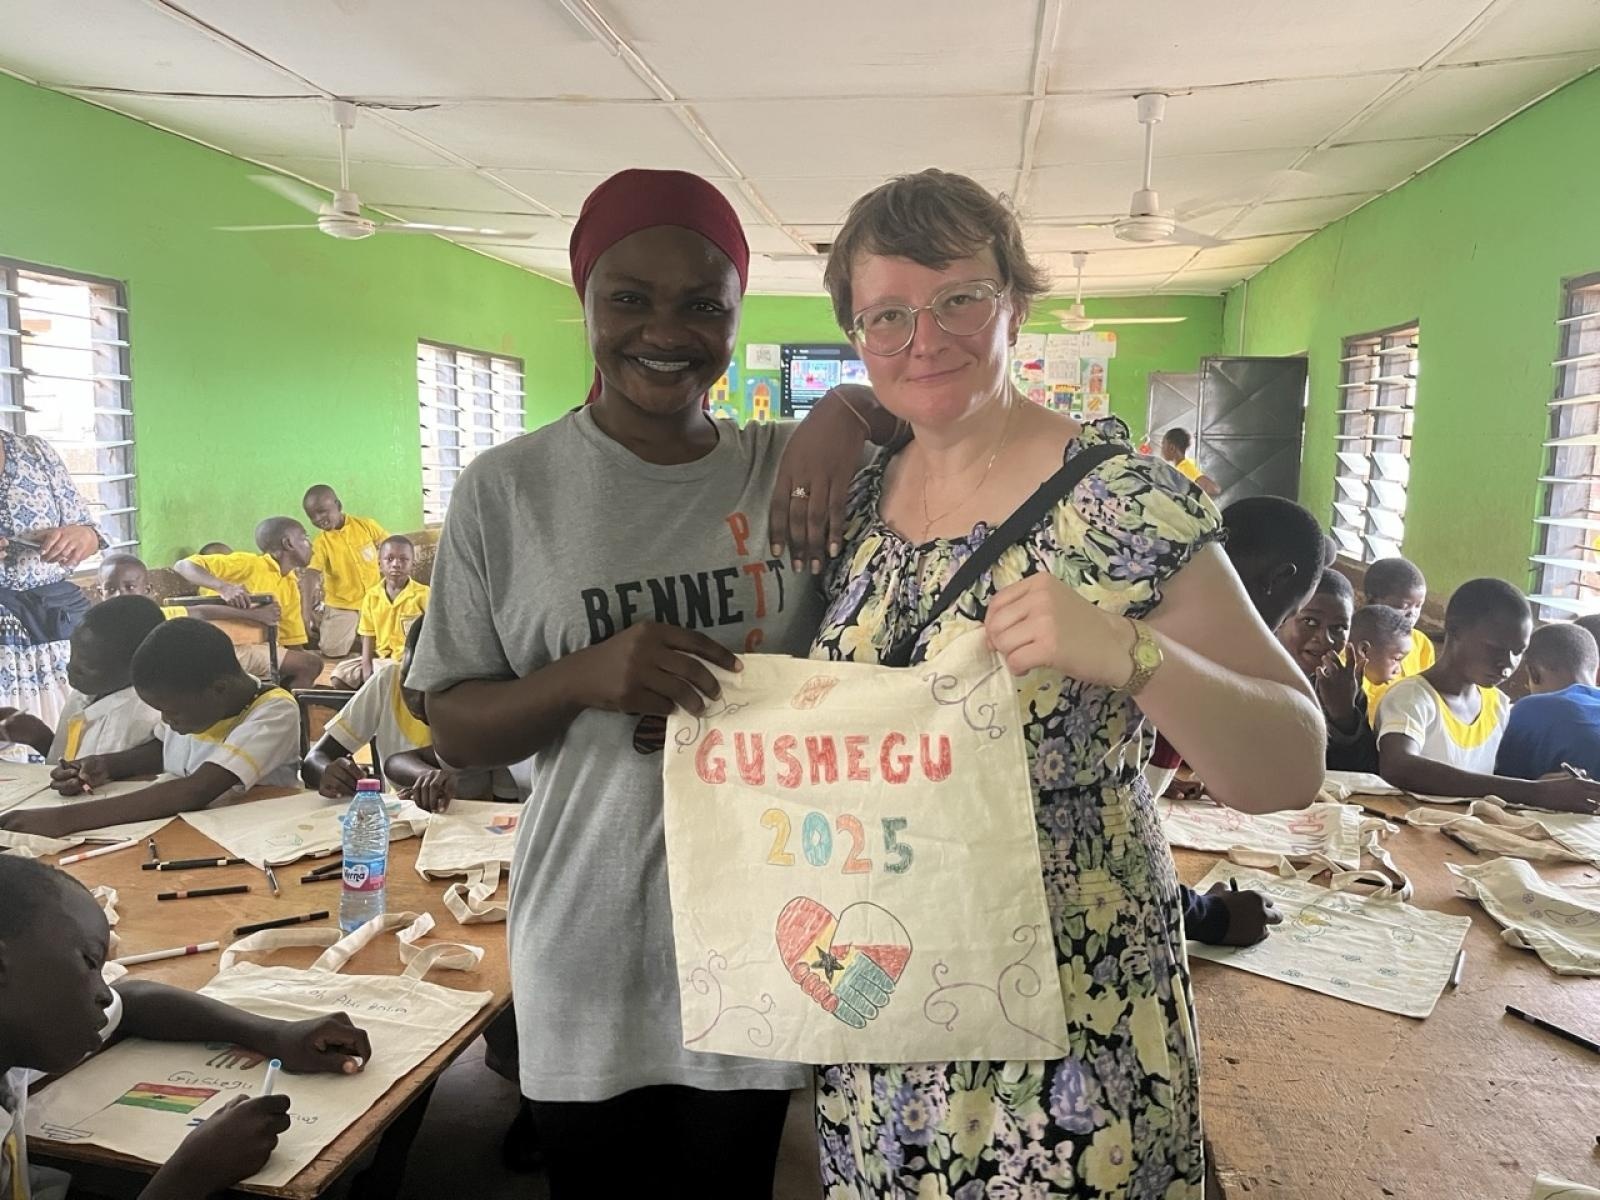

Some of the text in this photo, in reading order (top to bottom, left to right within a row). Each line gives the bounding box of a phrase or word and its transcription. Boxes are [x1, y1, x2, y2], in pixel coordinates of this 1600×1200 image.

[581, 559, 785, 645] BENNETT
[694, 728, 953, 789] GUSHEGU
[760, 808, 914, 875] 2025
